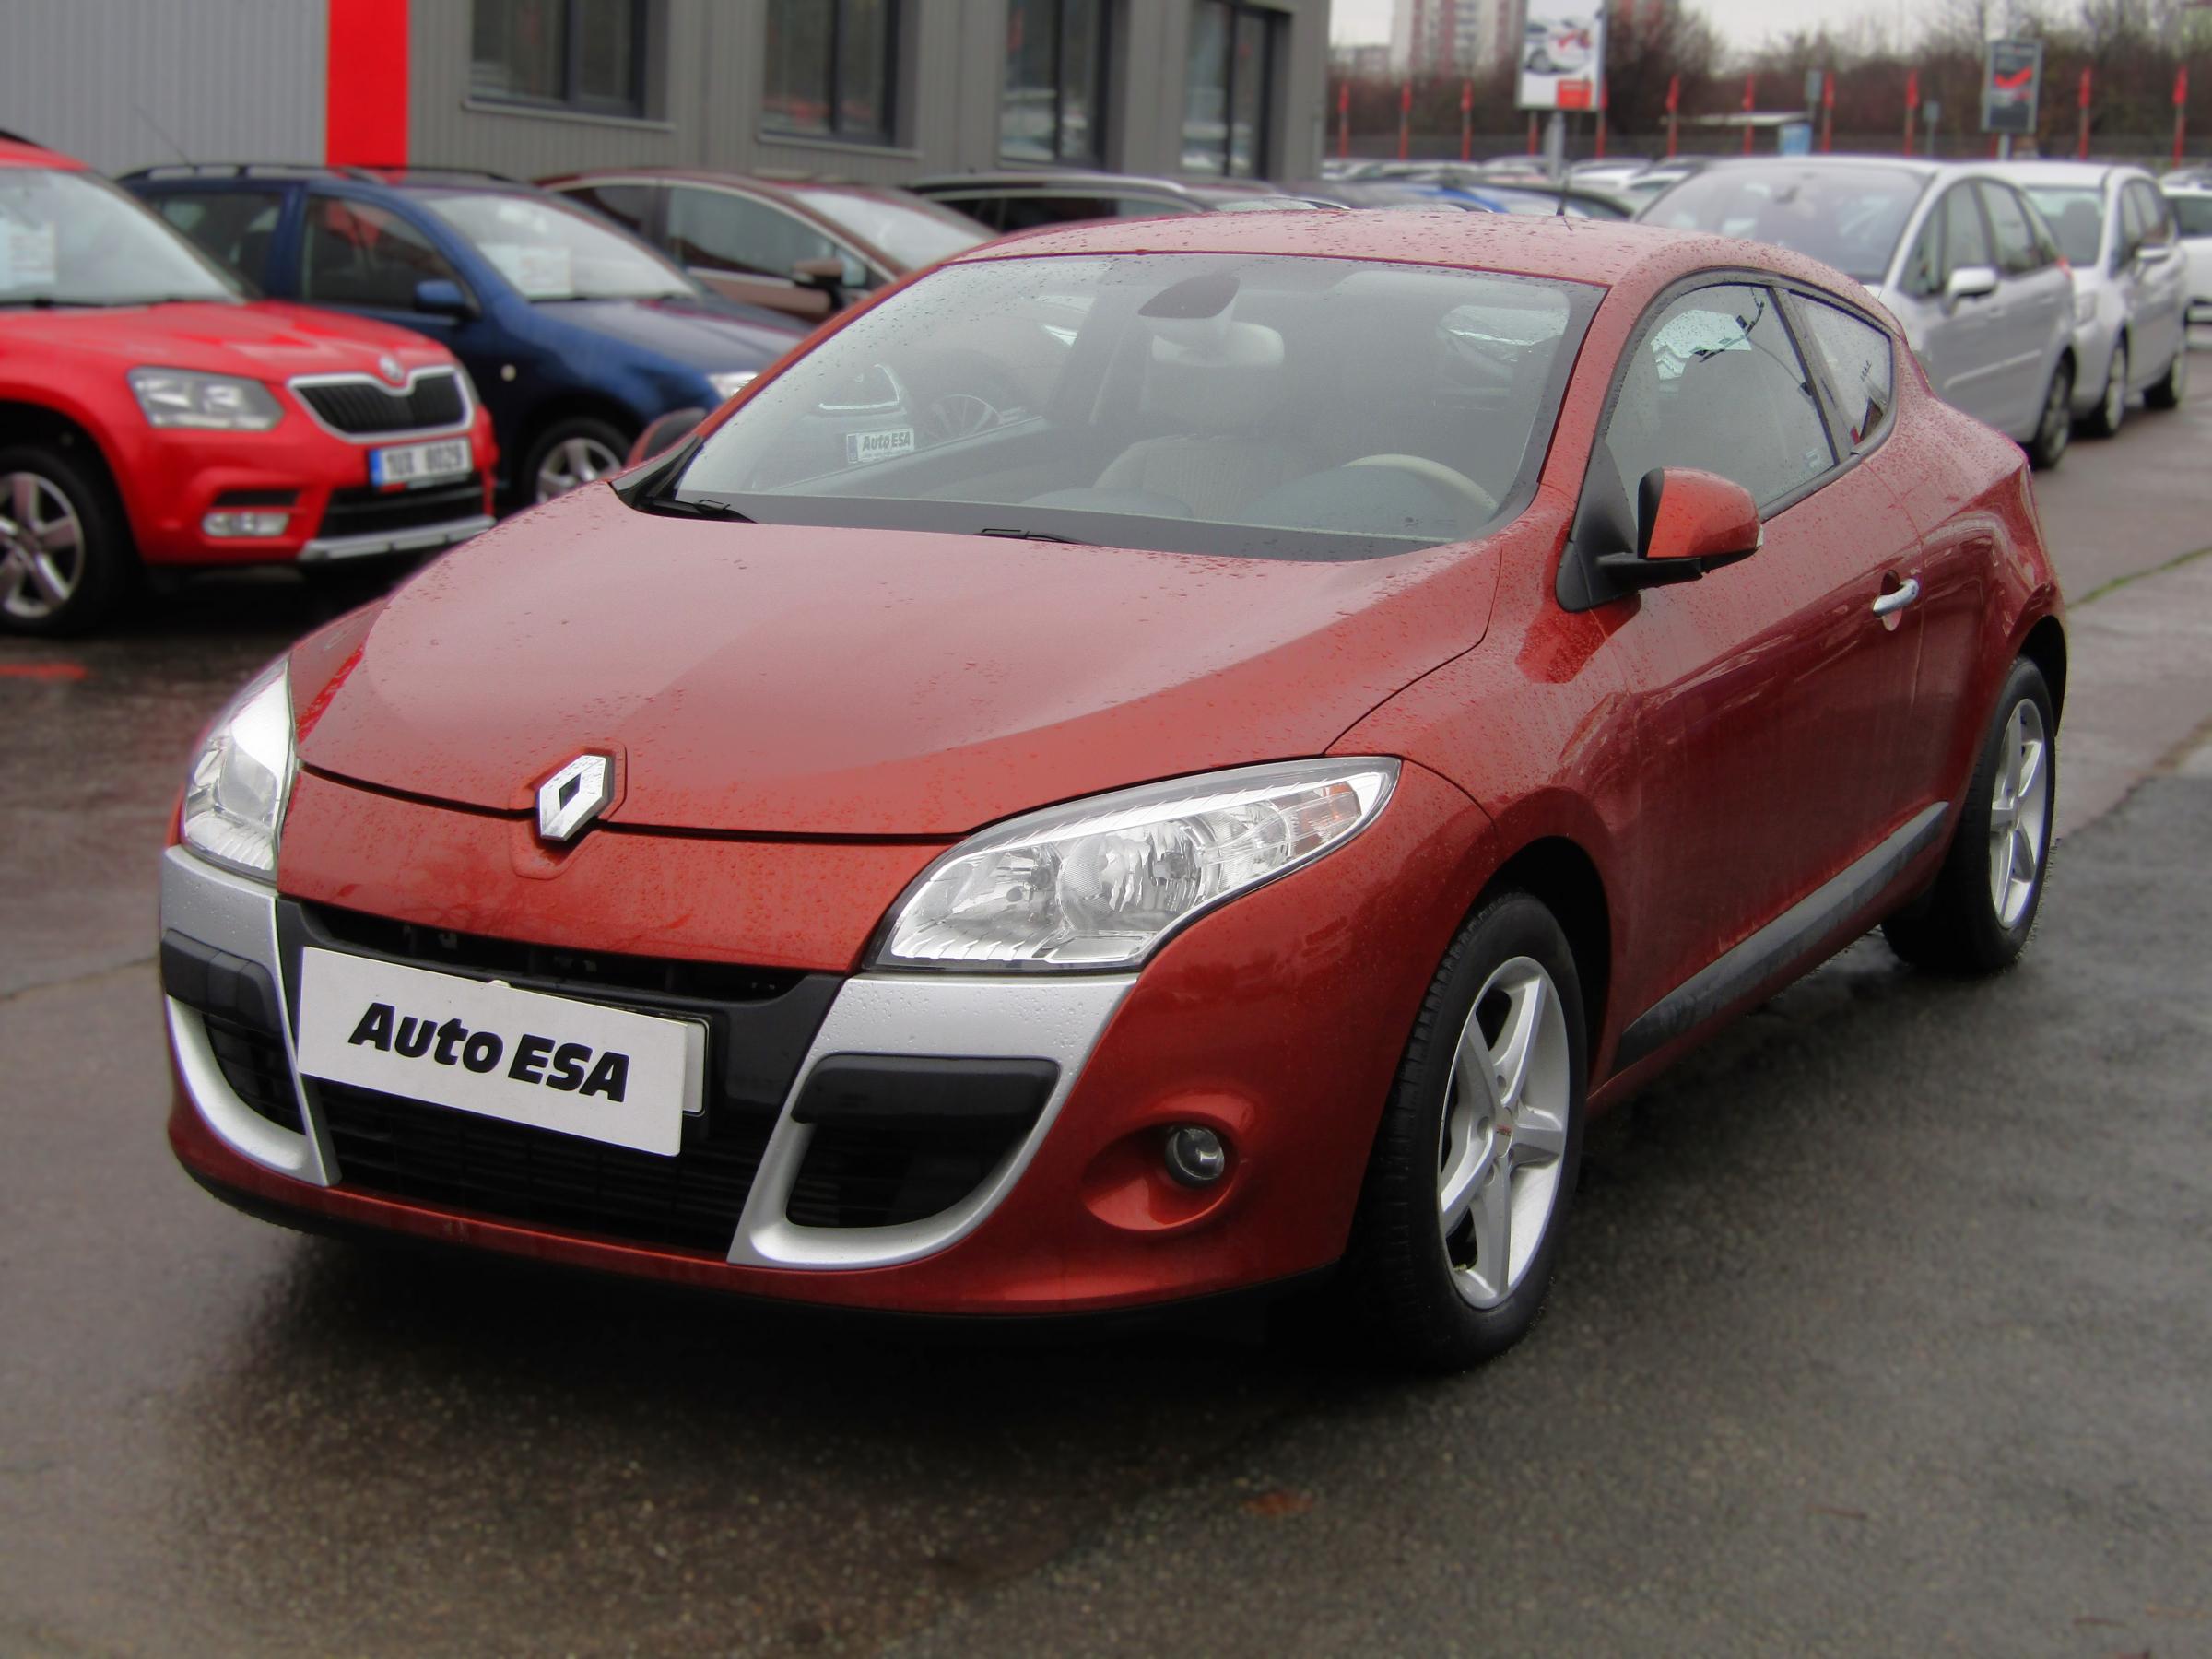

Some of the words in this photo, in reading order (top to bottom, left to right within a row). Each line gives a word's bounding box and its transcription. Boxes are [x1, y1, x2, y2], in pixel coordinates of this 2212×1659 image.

[891, 431, 911, 448] ESA
[348, 1002, 504, 1074] Auto
[508, 1033, 629, 1102] ESA
